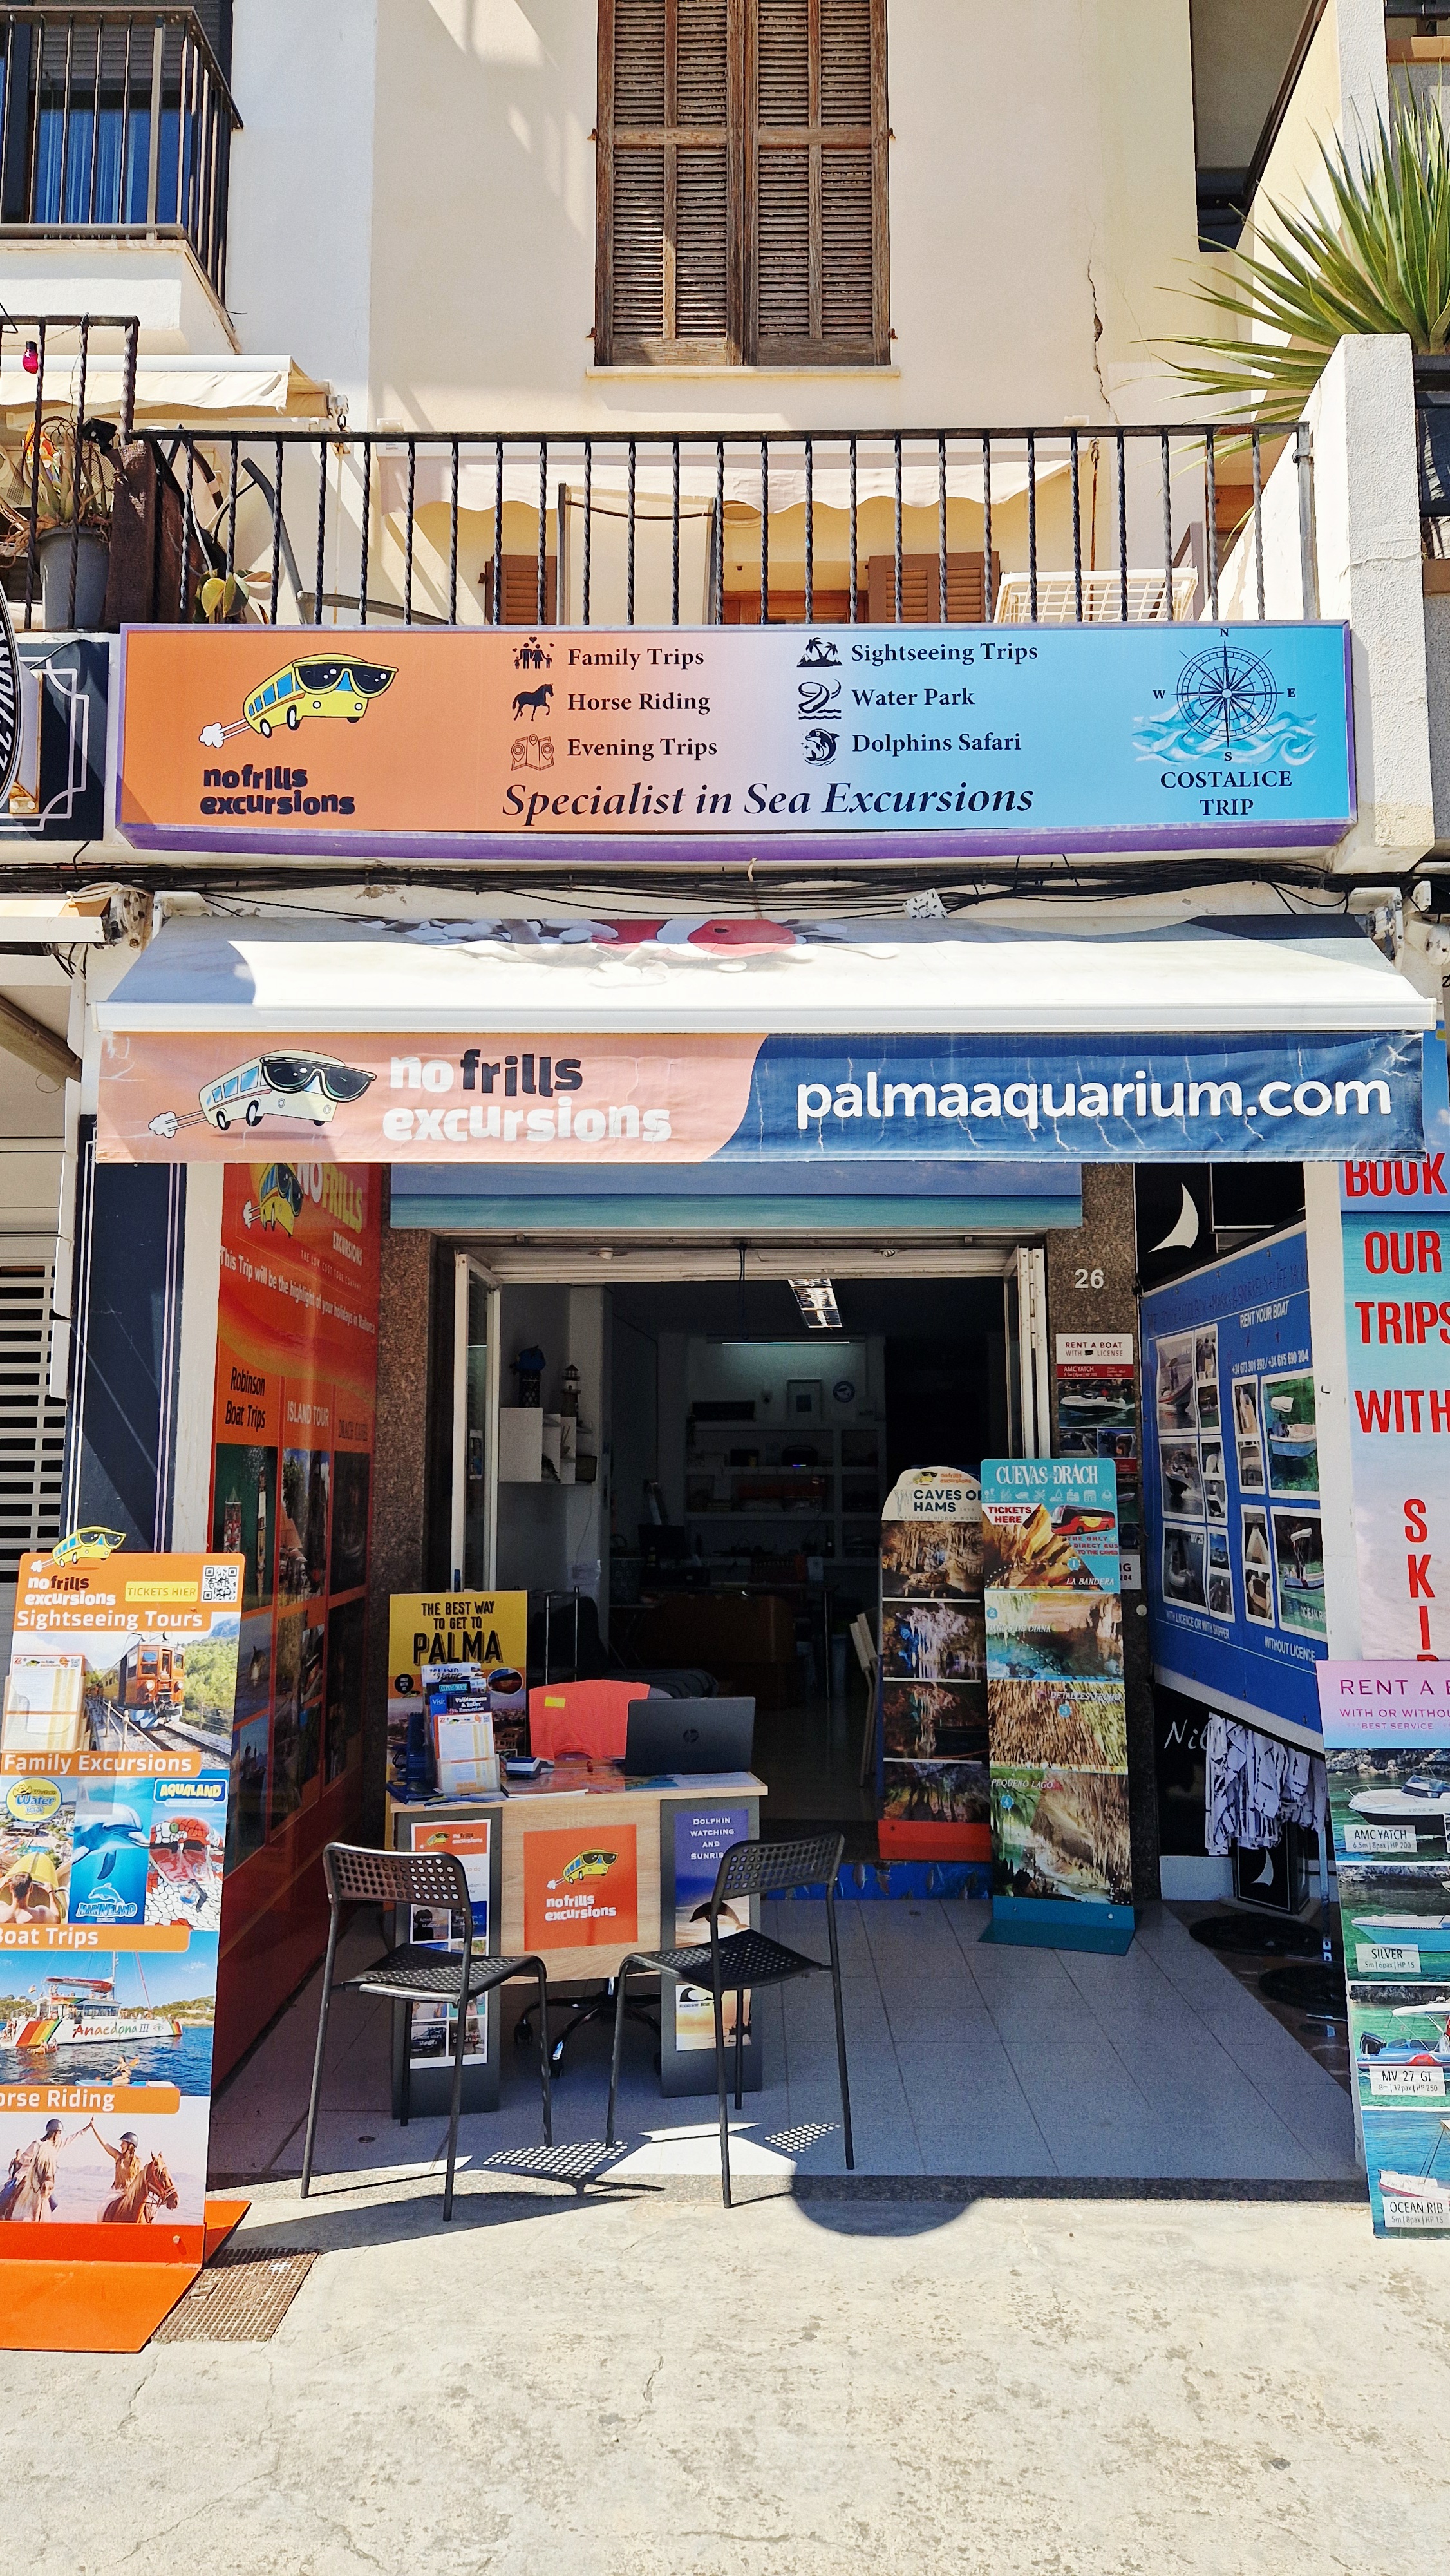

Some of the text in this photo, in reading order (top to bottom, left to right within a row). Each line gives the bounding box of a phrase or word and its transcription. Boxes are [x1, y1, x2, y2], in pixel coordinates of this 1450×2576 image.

[1219, 629, 1229, 637] N
[568, 647, 704, 671] Family Trips
[851, 643, 1039, 663] Sightseeing Trips
[852, 688, 975, 706] Water Park
[1153, 690, 1165, 699] W
[1288, 689, 1296, 697] E
[568, 692, 710, 715] Horse Riding
[567, 737, 717, 761] Evening Trips
[852, 732, 1021, 757] Dolphins Safari
[1225, 752, 1232, 761] S
[1161, 771, 1292, 788] COSTALICE
[200, 790, 355, 815] excursions
[503, 781, 1033, 826] Specialist in Sea Excursions
[1200, 799, 1254, 816] TRIP
[798, 1070, 1391, 1130] palmaaquarium.com
[382, 1098, 672, 1143] excursions
[1345, 1153, 1448, 1197] BOOK
[1364, 1231, 1442, 1274] OUR
[220, 1246, 237, 1271] This
[238, 1254, 254, 1282] Trip
[255, 1265, 267, 1285] will
[268, 1270, 277, 1289] be
[278, 1274, 289, 1294] the
[1075, 1269, 1104, 1289] 26
[1240, 1300, 1289, 1328] RENT YOUR BOAT
[231, 1367, 265, 1396] Robinson
[225, 1400, 266, 1432] Boat Trips
[287, 1400, 329, 1427] ISLAND TOUR
[1355, 1390, 1450, 1433] WITH
[996, 1464, 1098, 1487] CUEVAS DRACH
[913, 1489, 962, 1501] CAVES
[914, 1502, 956, 1513] HAMS
[994, 1515, 1022, 1524] HERE
[24, 1589, 117, 1606] excursions
[127, 1587, 196, 1596] TICKETS HIER
[422, 1600, 495, 1615] THE BEST WAY
[17, 1609, 203, 1631] Sightseeing Tours
[434, 1616, 482, 1630] TO GET TO
[413, 1630, 504, 1666] PALMA
[1265, 1636, 1315, 1663] WITHOUT LICENCE
[1051, 1691, 1090, 1700] DETALLES
[1340, 1680, 1408, 1695] RENT
[1420, 1680, 1435, 1695] A
[1339, 1709, 1373, 1718] WITH
[1379, 1709, 1397, 1718] OR
[4, 1755, 191, 1774] Family Excursions
[160, 1783, 222, 1797] AQUALAND
[16, 1794, 56, 1806] Water
[1355, 1829, 1407, 1841] AMC YATCH
[78, 1903, 137, 1916] MARINELAND
[545, 1906, 616, 1921] excursions
[0, 1927, 98, 1948] oat Trips
[1371, 1948, 1403, 1960] SILVER
[1382, 2070, 1433, 2082] MV 27 GT
[1426, 2084, 1438, 2092] 250
[47, 2088, 115, 2112] Riding
[1390, 2202, 1444, 2214] OCEAN RIB
